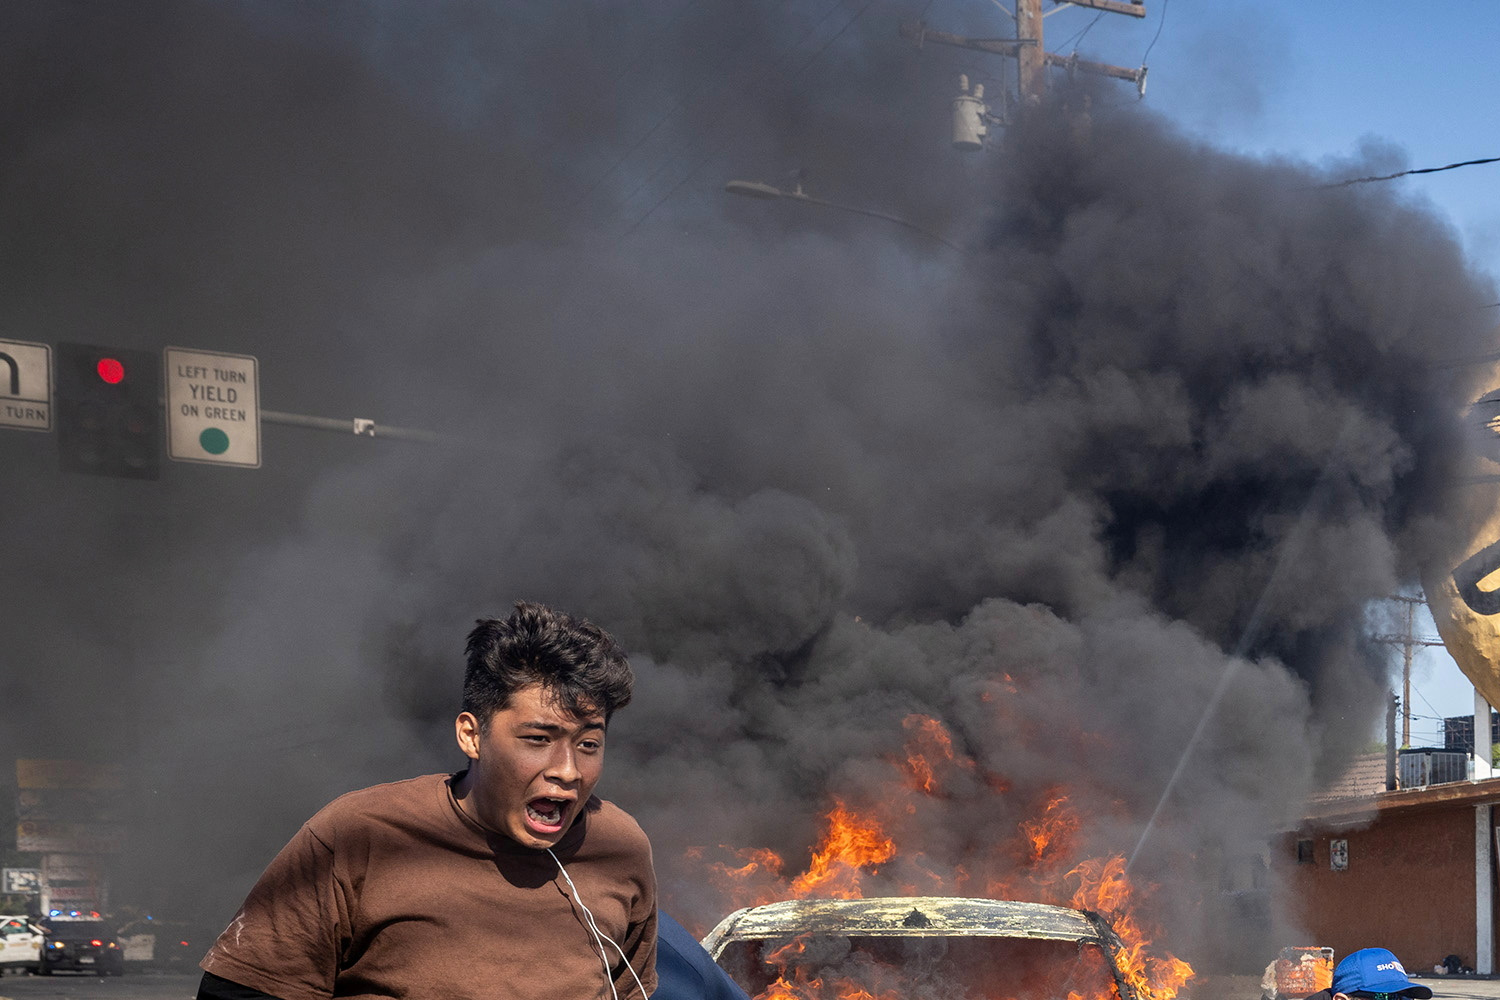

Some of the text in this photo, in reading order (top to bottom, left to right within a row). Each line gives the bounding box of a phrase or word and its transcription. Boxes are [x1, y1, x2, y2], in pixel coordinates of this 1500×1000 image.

[177, 365, 247, 383] LEFT TURN
[189, 384, 238, 404] YIELD
[6, 405, 46, 422] TURN
[181, 403, 247, 422] ON GREEN
